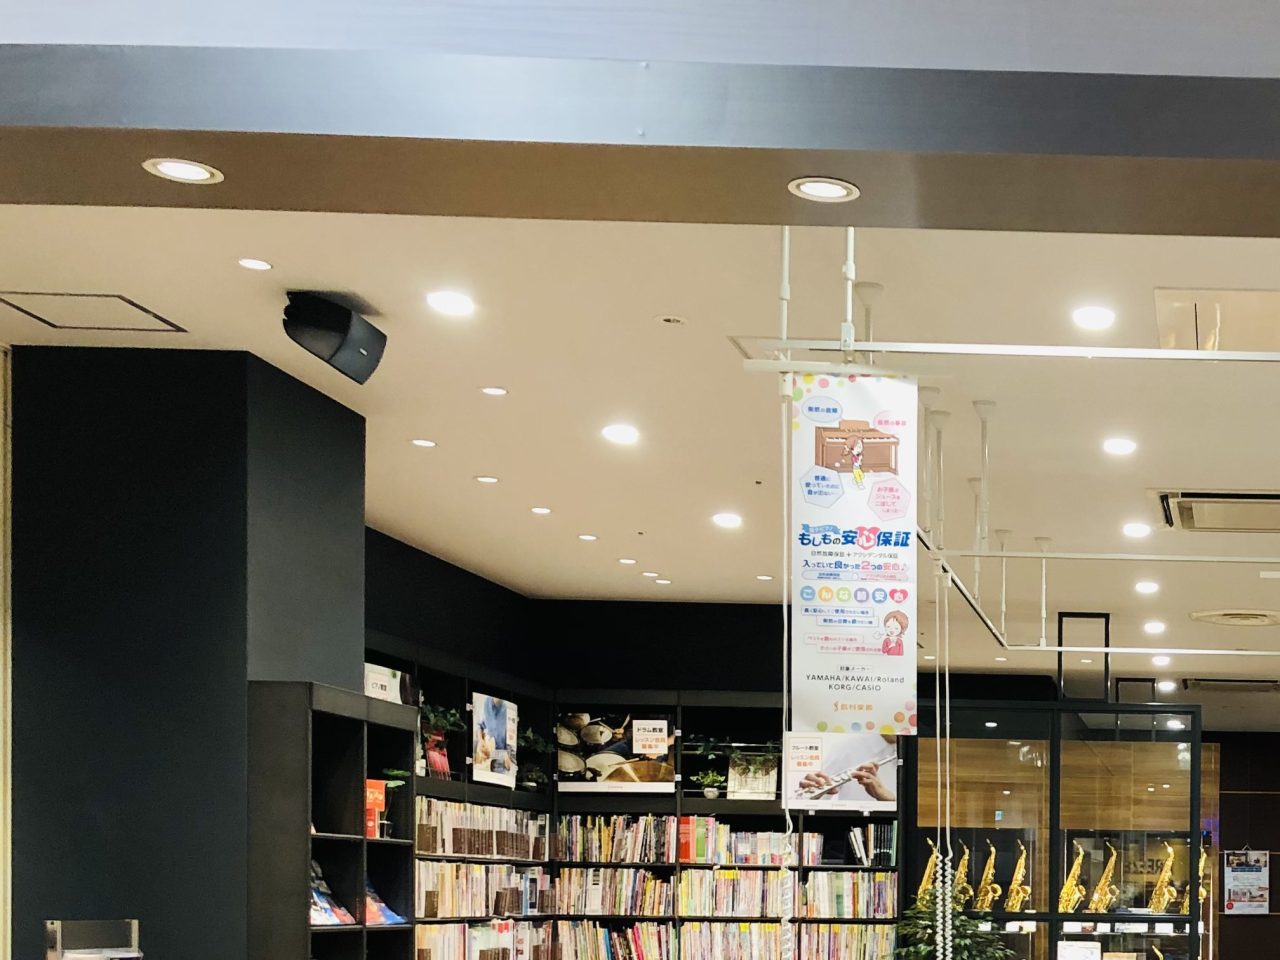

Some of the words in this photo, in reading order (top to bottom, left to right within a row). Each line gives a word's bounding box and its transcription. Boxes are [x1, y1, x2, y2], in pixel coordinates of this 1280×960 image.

[798, 529, 911, 547] もしもの安心保証
[806, 674, 905, 683] YAMAHA/KAWAI/Roland
